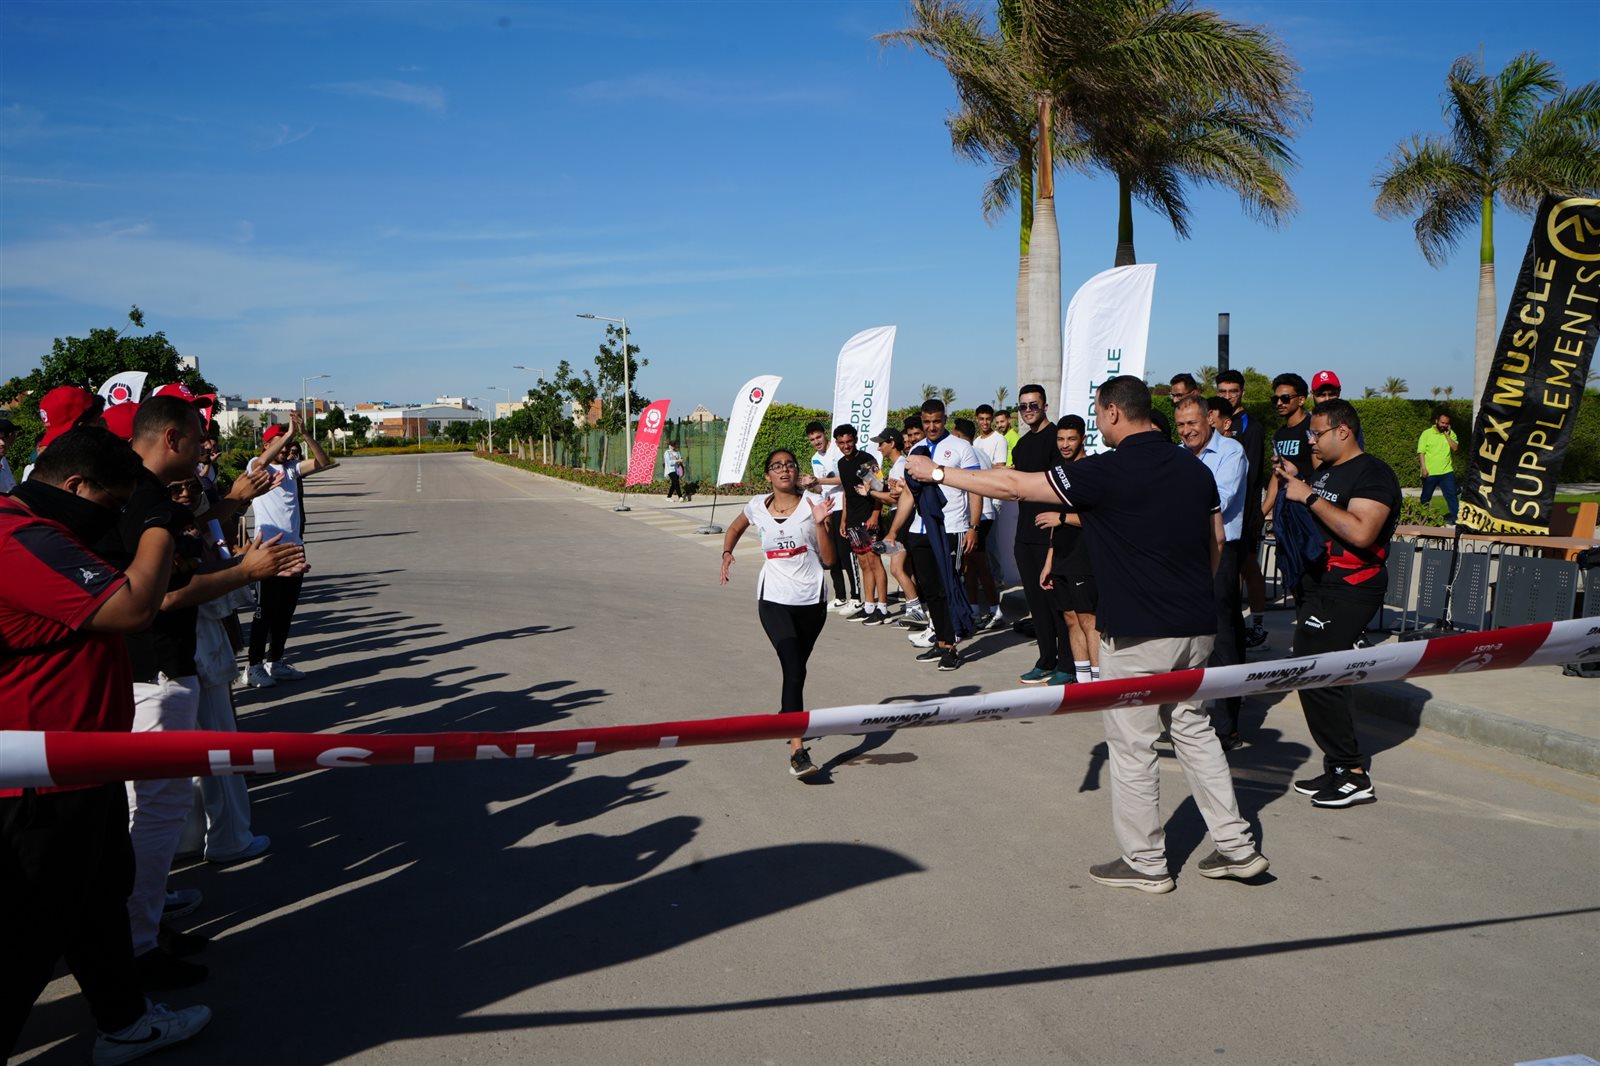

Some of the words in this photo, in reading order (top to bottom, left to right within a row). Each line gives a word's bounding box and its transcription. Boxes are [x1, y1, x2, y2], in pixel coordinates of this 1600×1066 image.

[1493, 257, 1556, 407] MUSCLE
[1510, 265, 1600, 519] SUPPLEMENTS
[1084, 380, 1100, 454] REDIT
[1478, 414, 1514, 508] ALEX
[777, 540, 796, 550] 370
[1471, 642, 1504, 654] E-JUST
[1245, 659, 1317, 682] RUNNING
[1344, 660, 1377, 671] E-JUST
[859, 706, 940, 726] RUNNING
[974, 706, 1010, 716] E-JUST
